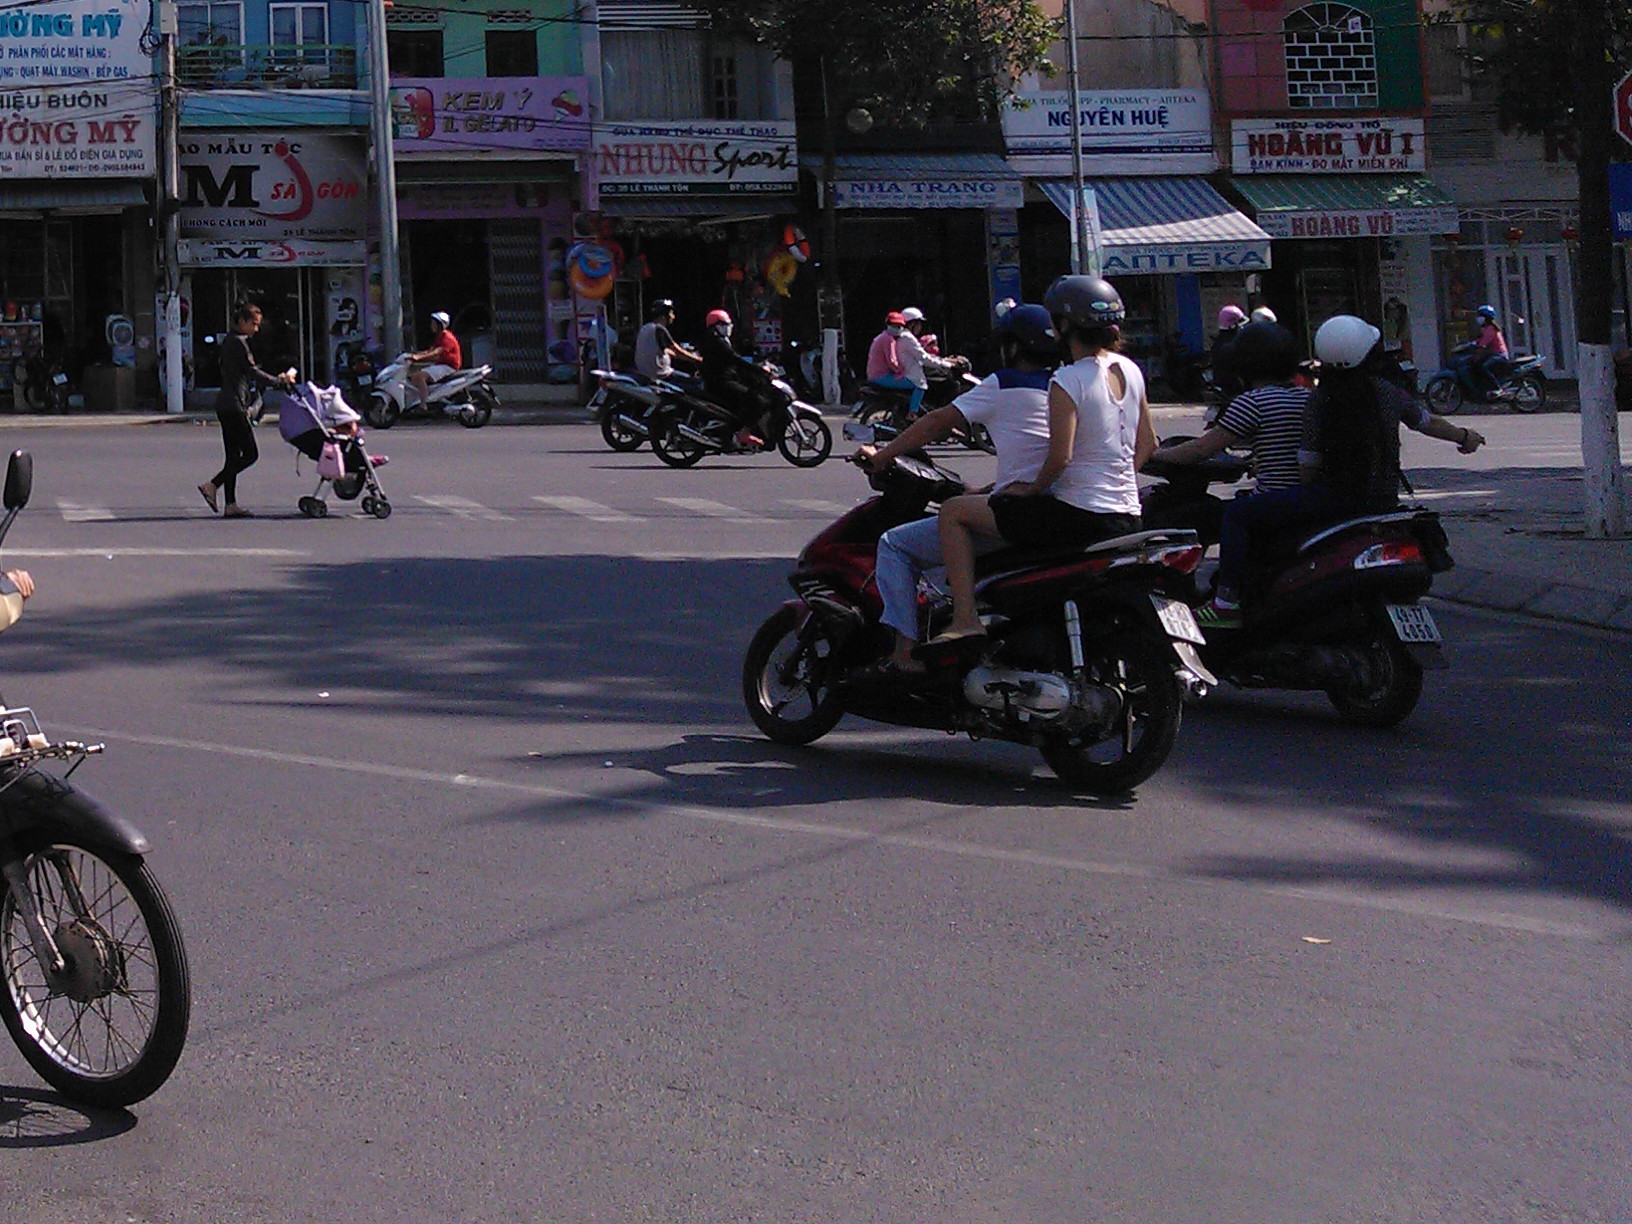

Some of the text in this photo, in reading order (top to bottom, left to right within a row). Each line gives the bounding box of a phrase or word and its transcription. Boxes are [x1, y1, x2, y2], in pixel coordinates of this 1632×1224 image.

[48, 90, 108, 108] BUÔN
[442, 91, 505, 112] KEM
[87, 114, 142, 145] MỸ
[465, 114, 536, 133] GELATO
[102, 150, 117, 160] GIA
[599, 141, 796, 178] NHUNG Sport
[180, 164, 260, 208] M
[850, 182, 996, 193] NHA TRANG
